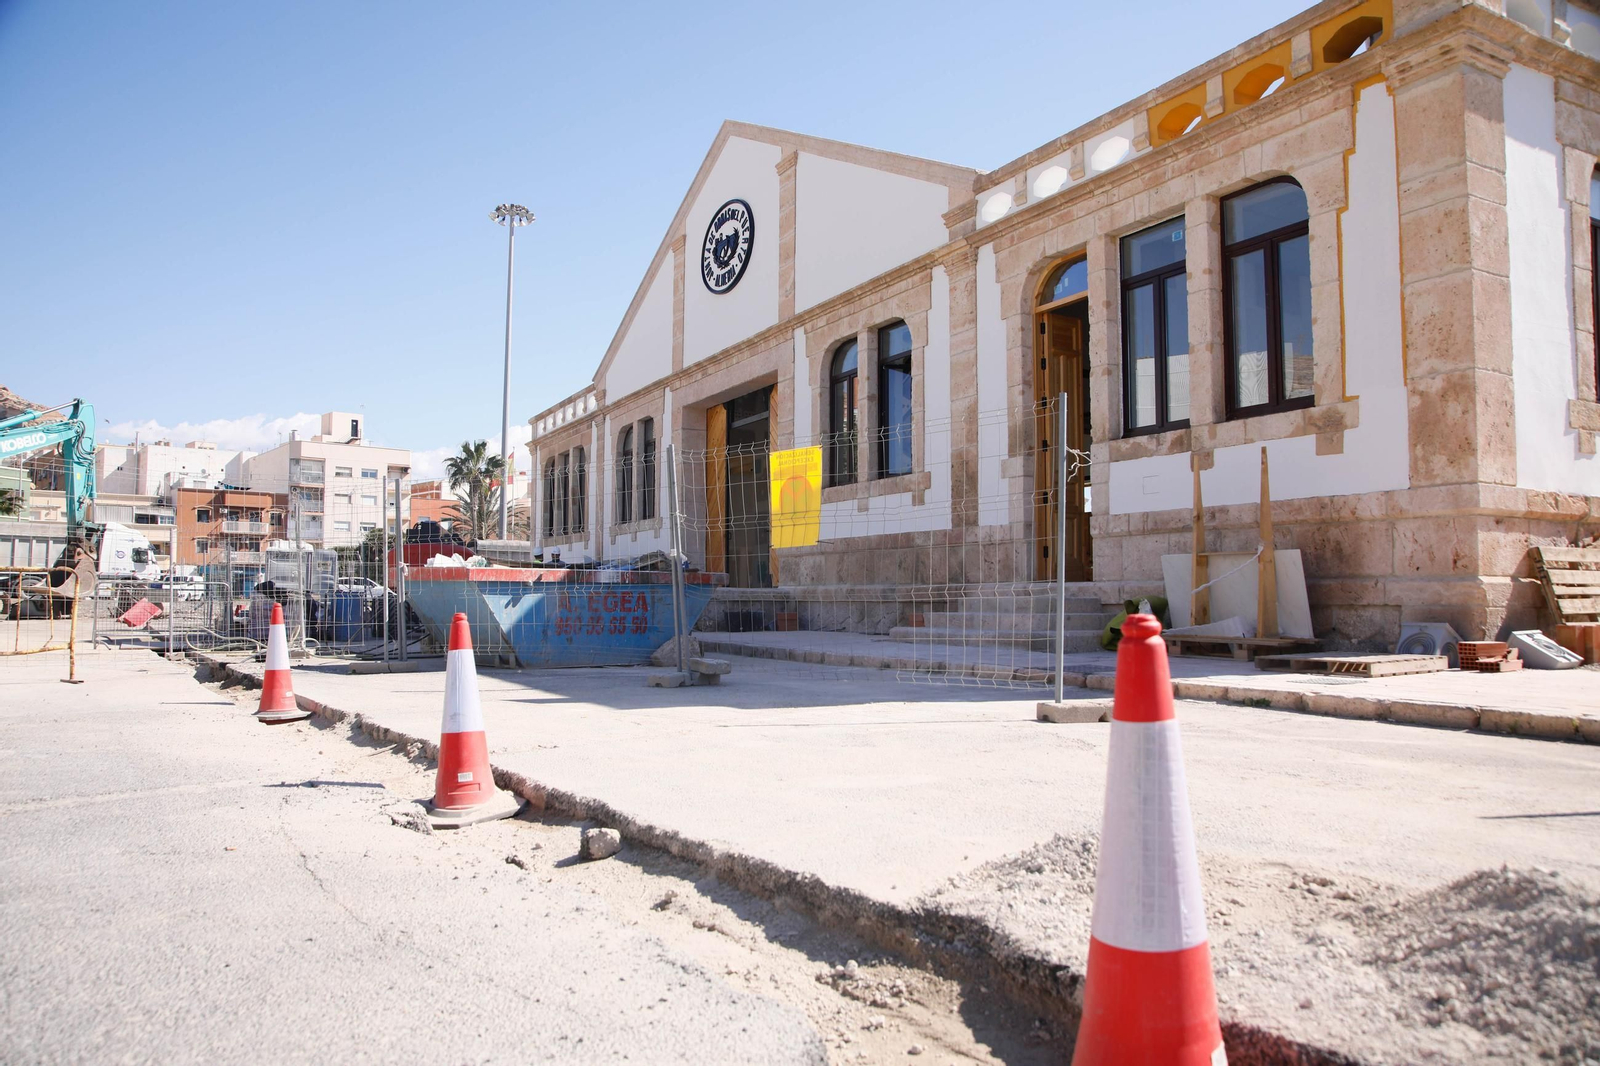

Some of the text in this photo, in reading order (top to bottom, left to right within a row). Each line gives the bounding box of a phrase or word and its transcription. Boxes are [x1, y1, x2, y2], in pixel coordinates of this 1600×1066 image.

[709, 230, 715, 245] DE
[738, 210, 749, 264] PUERTO
[0, 432, 46, 452] KOBELCO
[558, 591, 648, 612] A. EGEA
[555, 617, 581, 635] 950
[631, 616, 648, 634] 50
